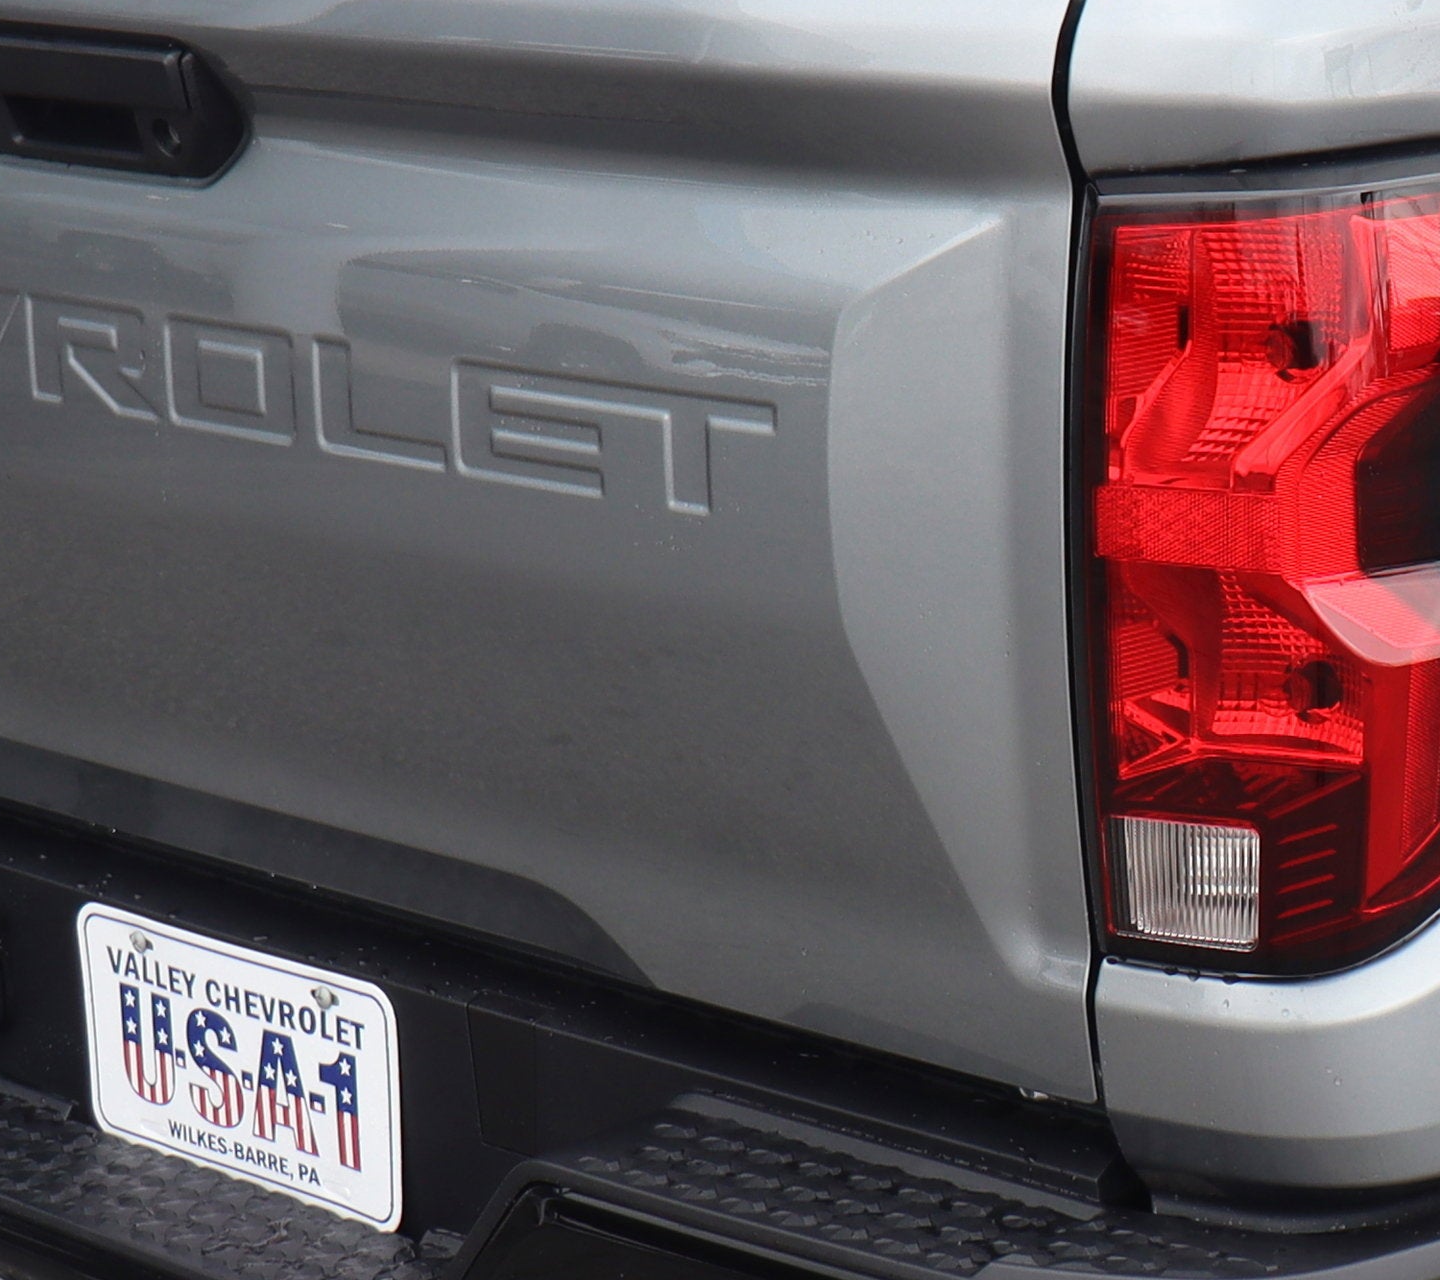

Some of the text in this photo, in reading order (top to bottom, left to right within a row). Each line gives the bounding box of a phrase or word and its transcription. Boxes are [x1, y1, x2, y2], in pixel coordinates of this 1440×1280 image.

[106, 945, 366, 1051] VALLEY CHEVROLET
[167, 1118, 321, 1188] WILKES-BARRE, PA
